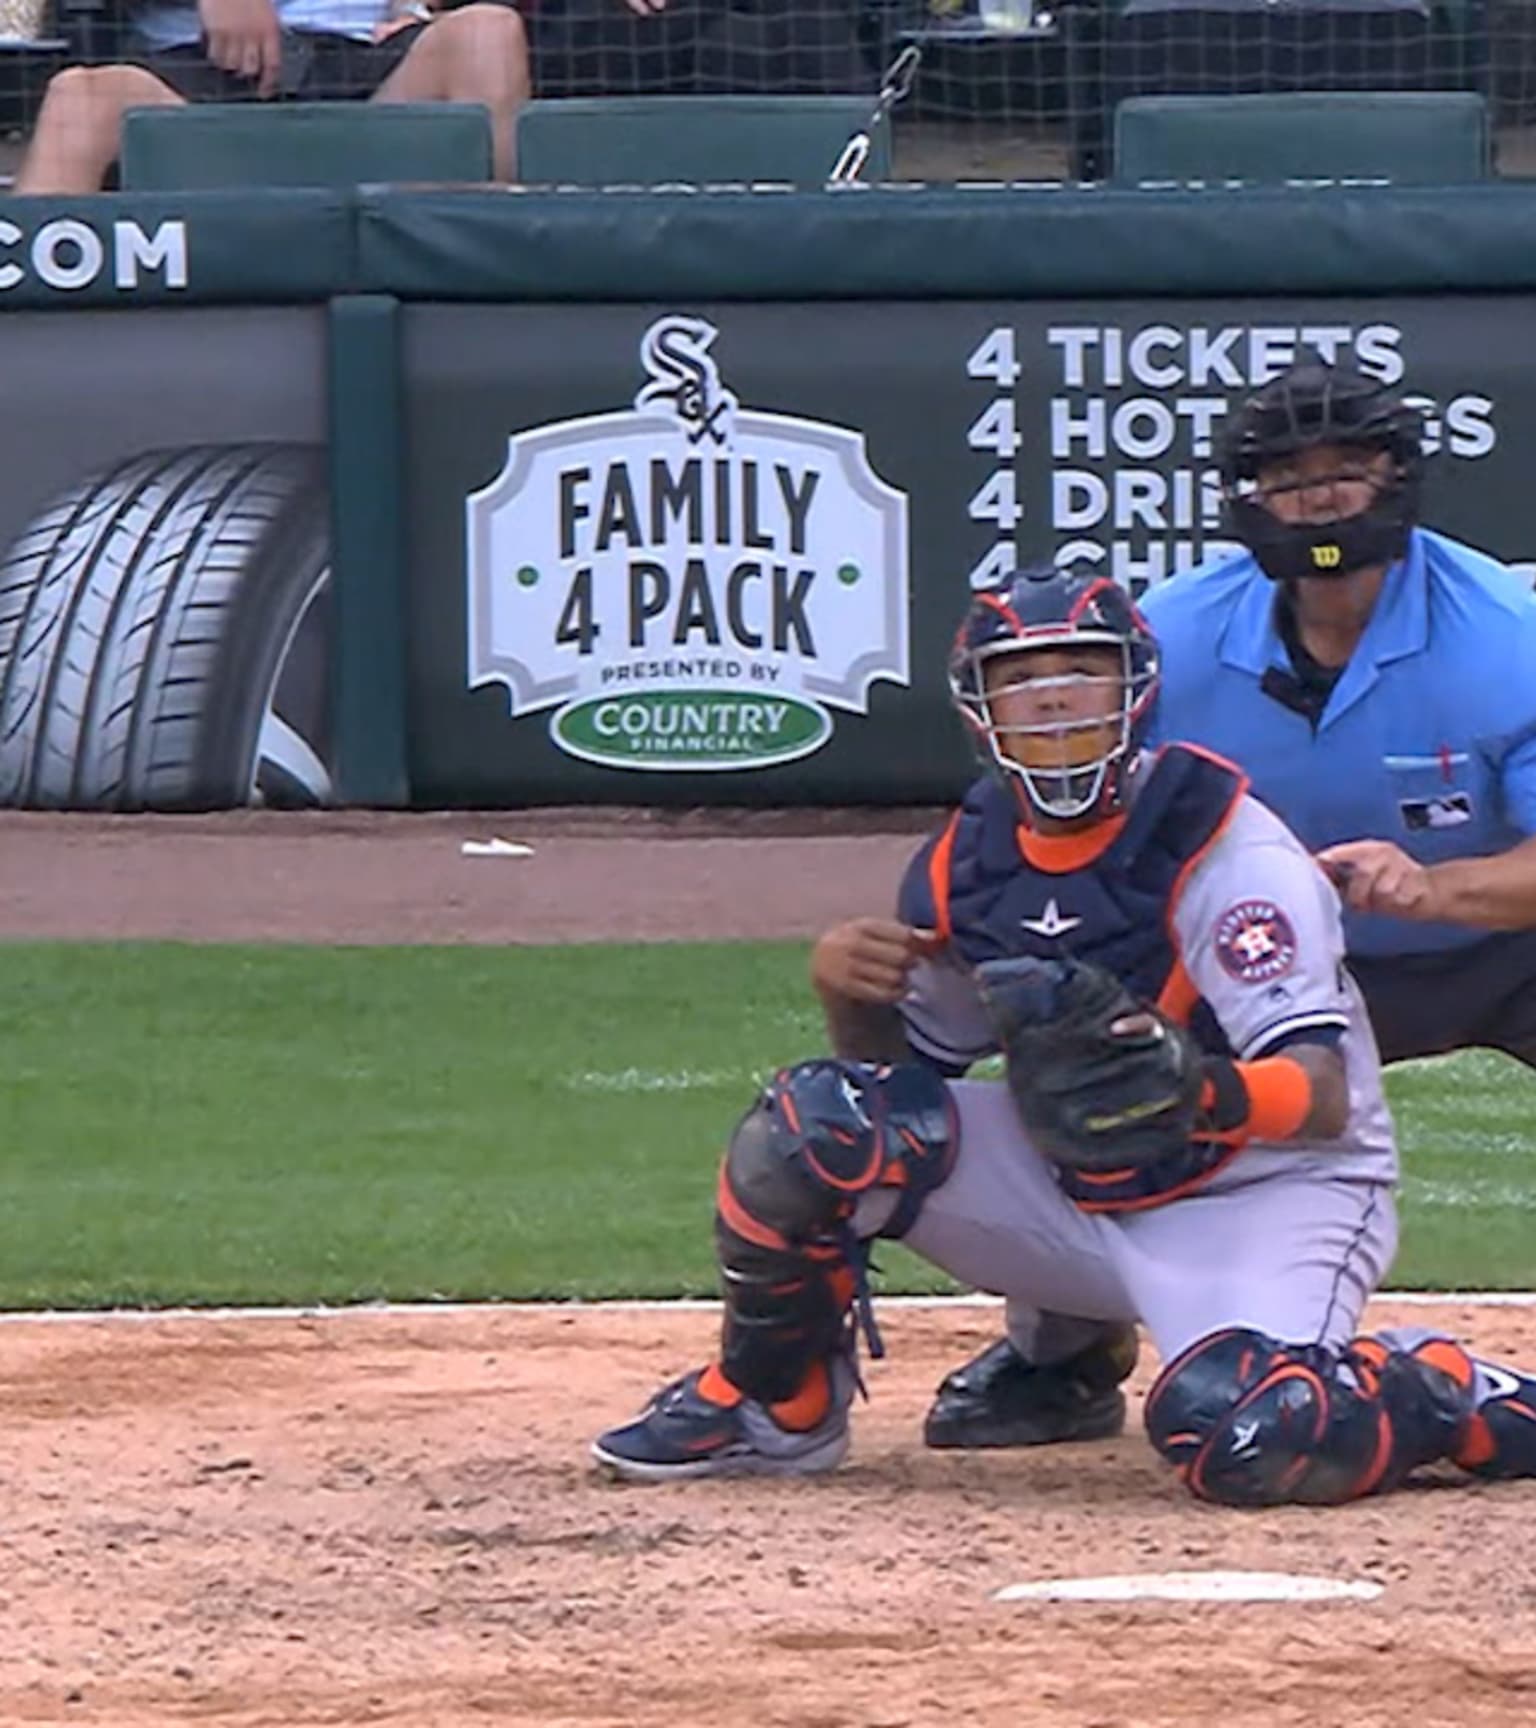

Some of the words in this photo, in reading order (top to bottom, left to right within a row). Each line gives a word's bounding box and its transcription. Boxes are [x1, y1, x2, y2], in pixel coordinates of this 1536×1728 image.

[966, 327, 1021, 387] 4
[1048, 326, 1403, 388] TICKETS
[968, 398, 1021, 456] 4
[1051, 398, 1227, 458] HOT
[559, 458, 820, 560] FAMILY
[969, 470, 1022, 528] 4
[969, 541, 1016, 590] 4
[555, 568, 600, 656] 4
[629, 560, 817, 659] PACK
[602, 659, 742, 683] PRESENTED
[750, 662, 780, 681] BY
[593, 704, 789, 735] COUNTRY
[630, 736, 752, 751] FINANCIAL
